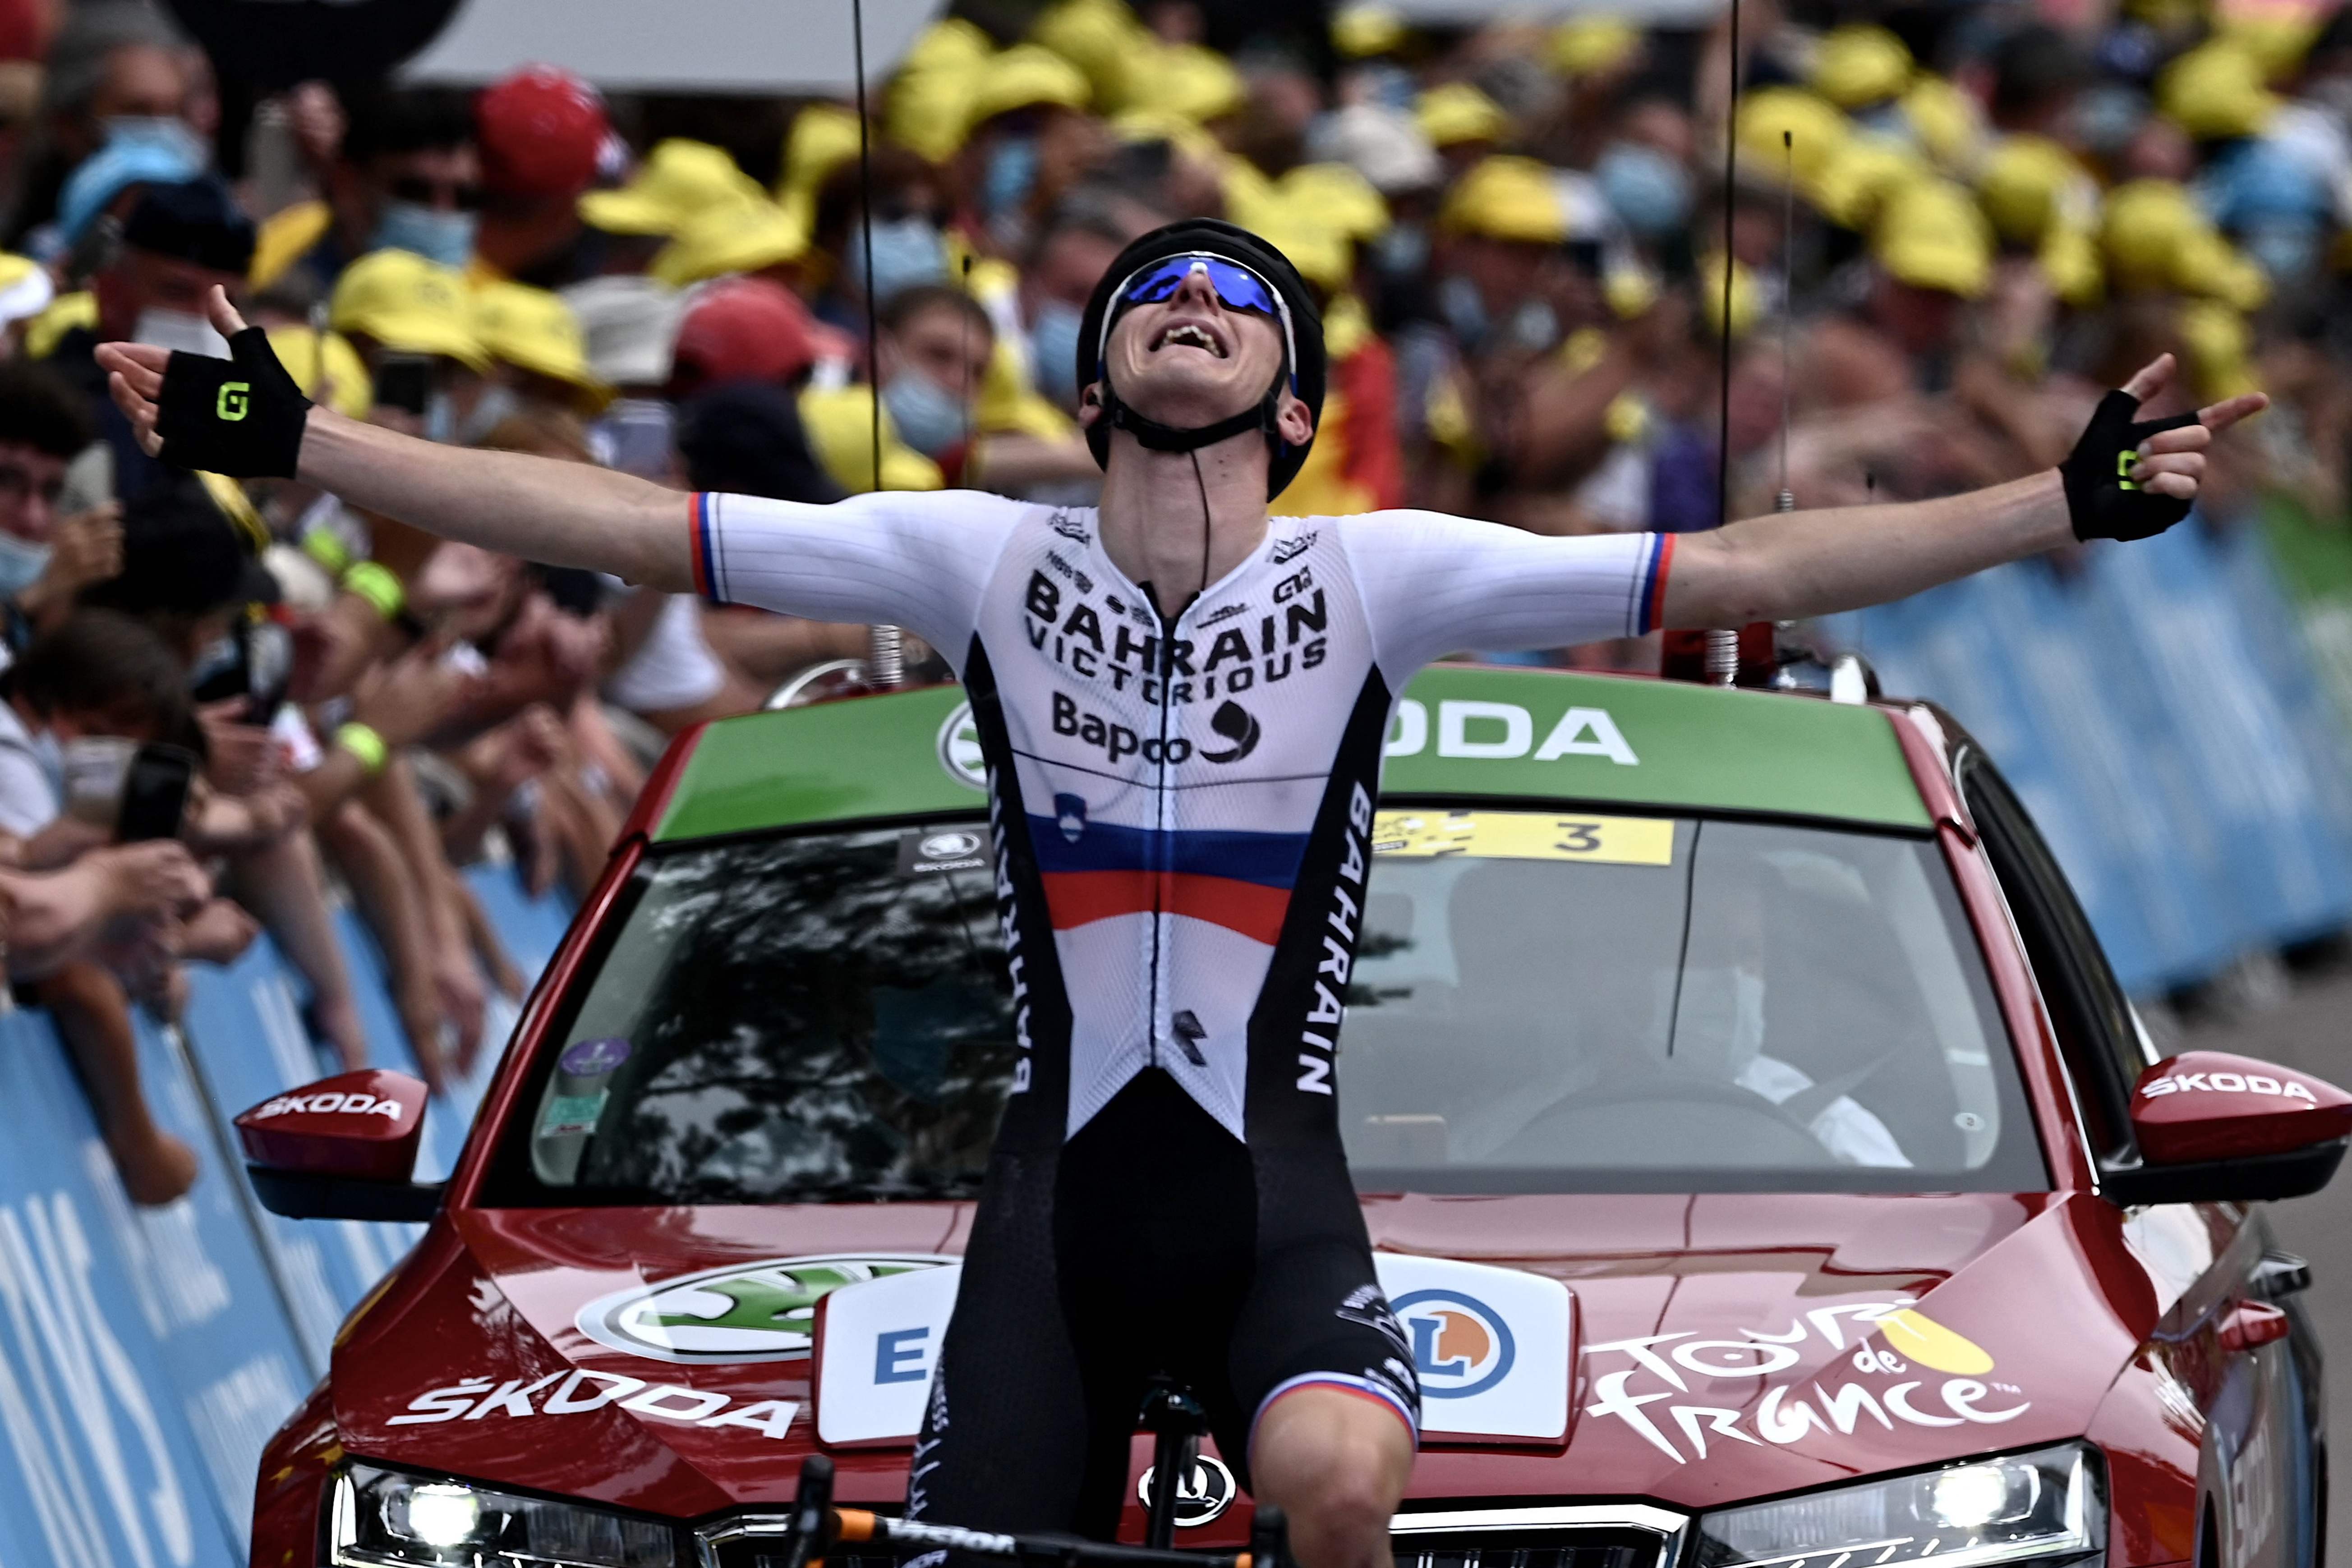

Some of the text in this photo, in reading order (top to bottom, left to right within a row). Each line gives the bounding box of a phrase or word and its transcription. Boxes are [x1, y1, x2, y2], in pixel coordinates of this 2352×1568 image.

[1025, 569, 1328, 678] BAHRAIN
[1024, 616, 1327, 705] VICTORIOUS
[1052, 691, 1192, 764] Bapco
[1553, 822, 1602, 853] 3
[1296, 780, 1372, 1095] BAHRAIN
[874, 1327, 930, 1385] E
[1580, 1298, 1928, 1393] TOUR
[1852, 1336, 1907, 1375] de
[385, 1368, 801, 1439] ŠKODA
